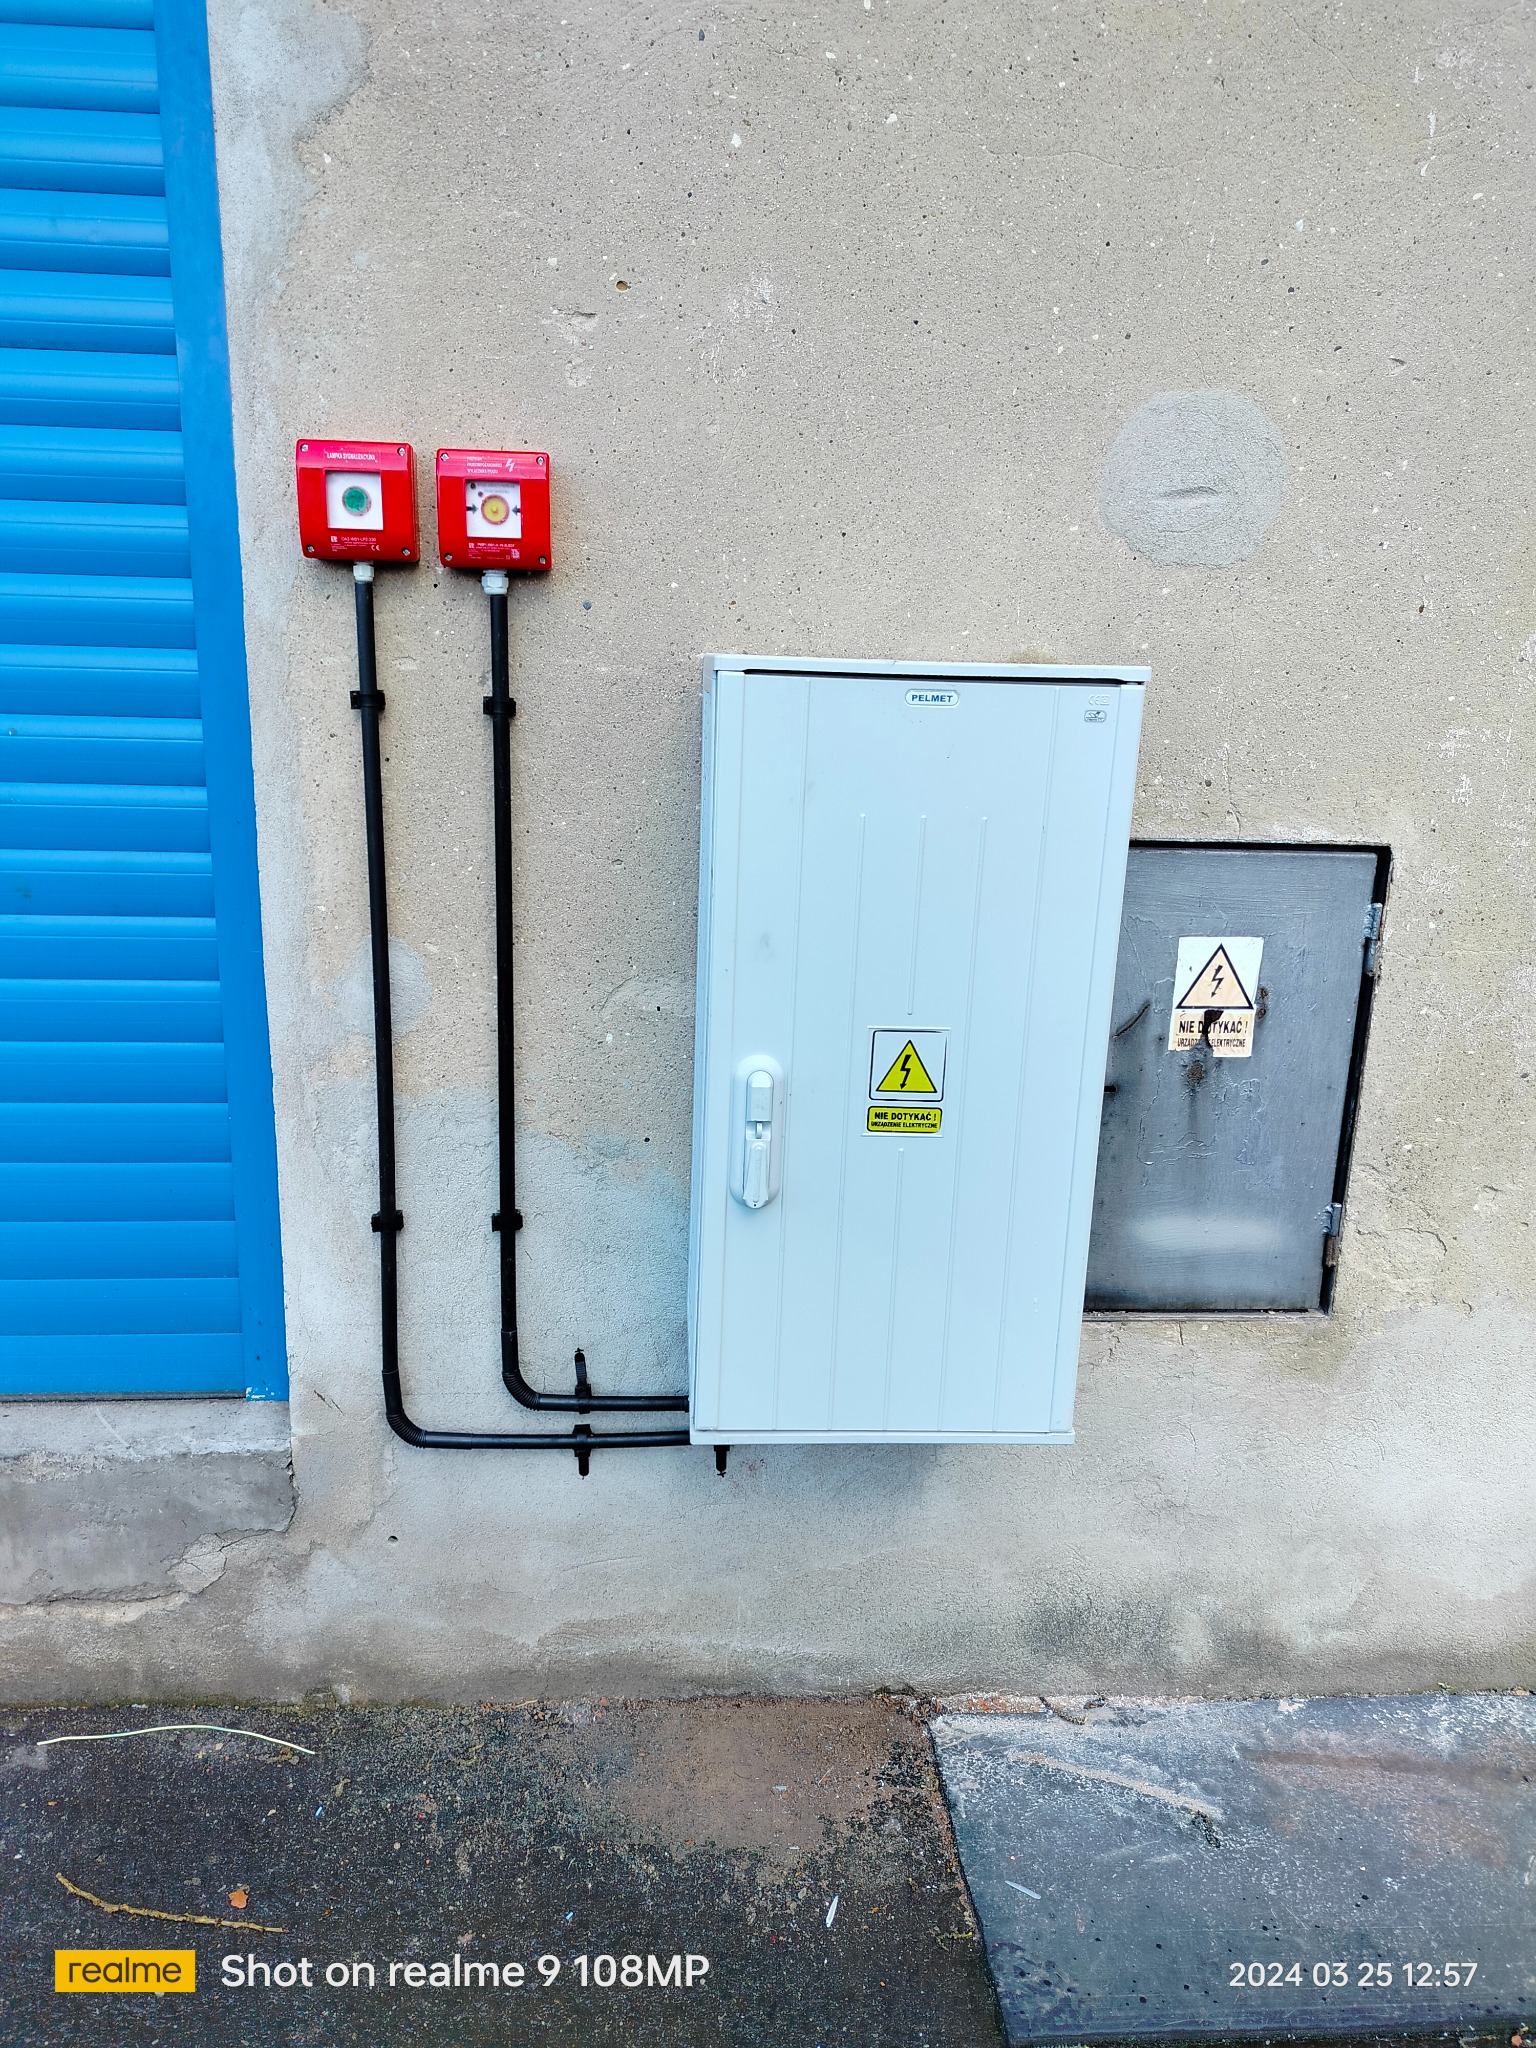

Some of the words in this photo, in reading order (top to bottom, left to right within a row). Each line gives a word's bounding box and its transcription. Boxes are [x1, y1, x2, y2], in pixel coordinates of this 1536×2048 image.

[911, 694, 954, 703] PELMET
[1178, 1020, 1195, 1034] NIE
[874, 1111, 889, 1120] NIE
[891, 1111, 932, 1121] DOTYKAĆ
